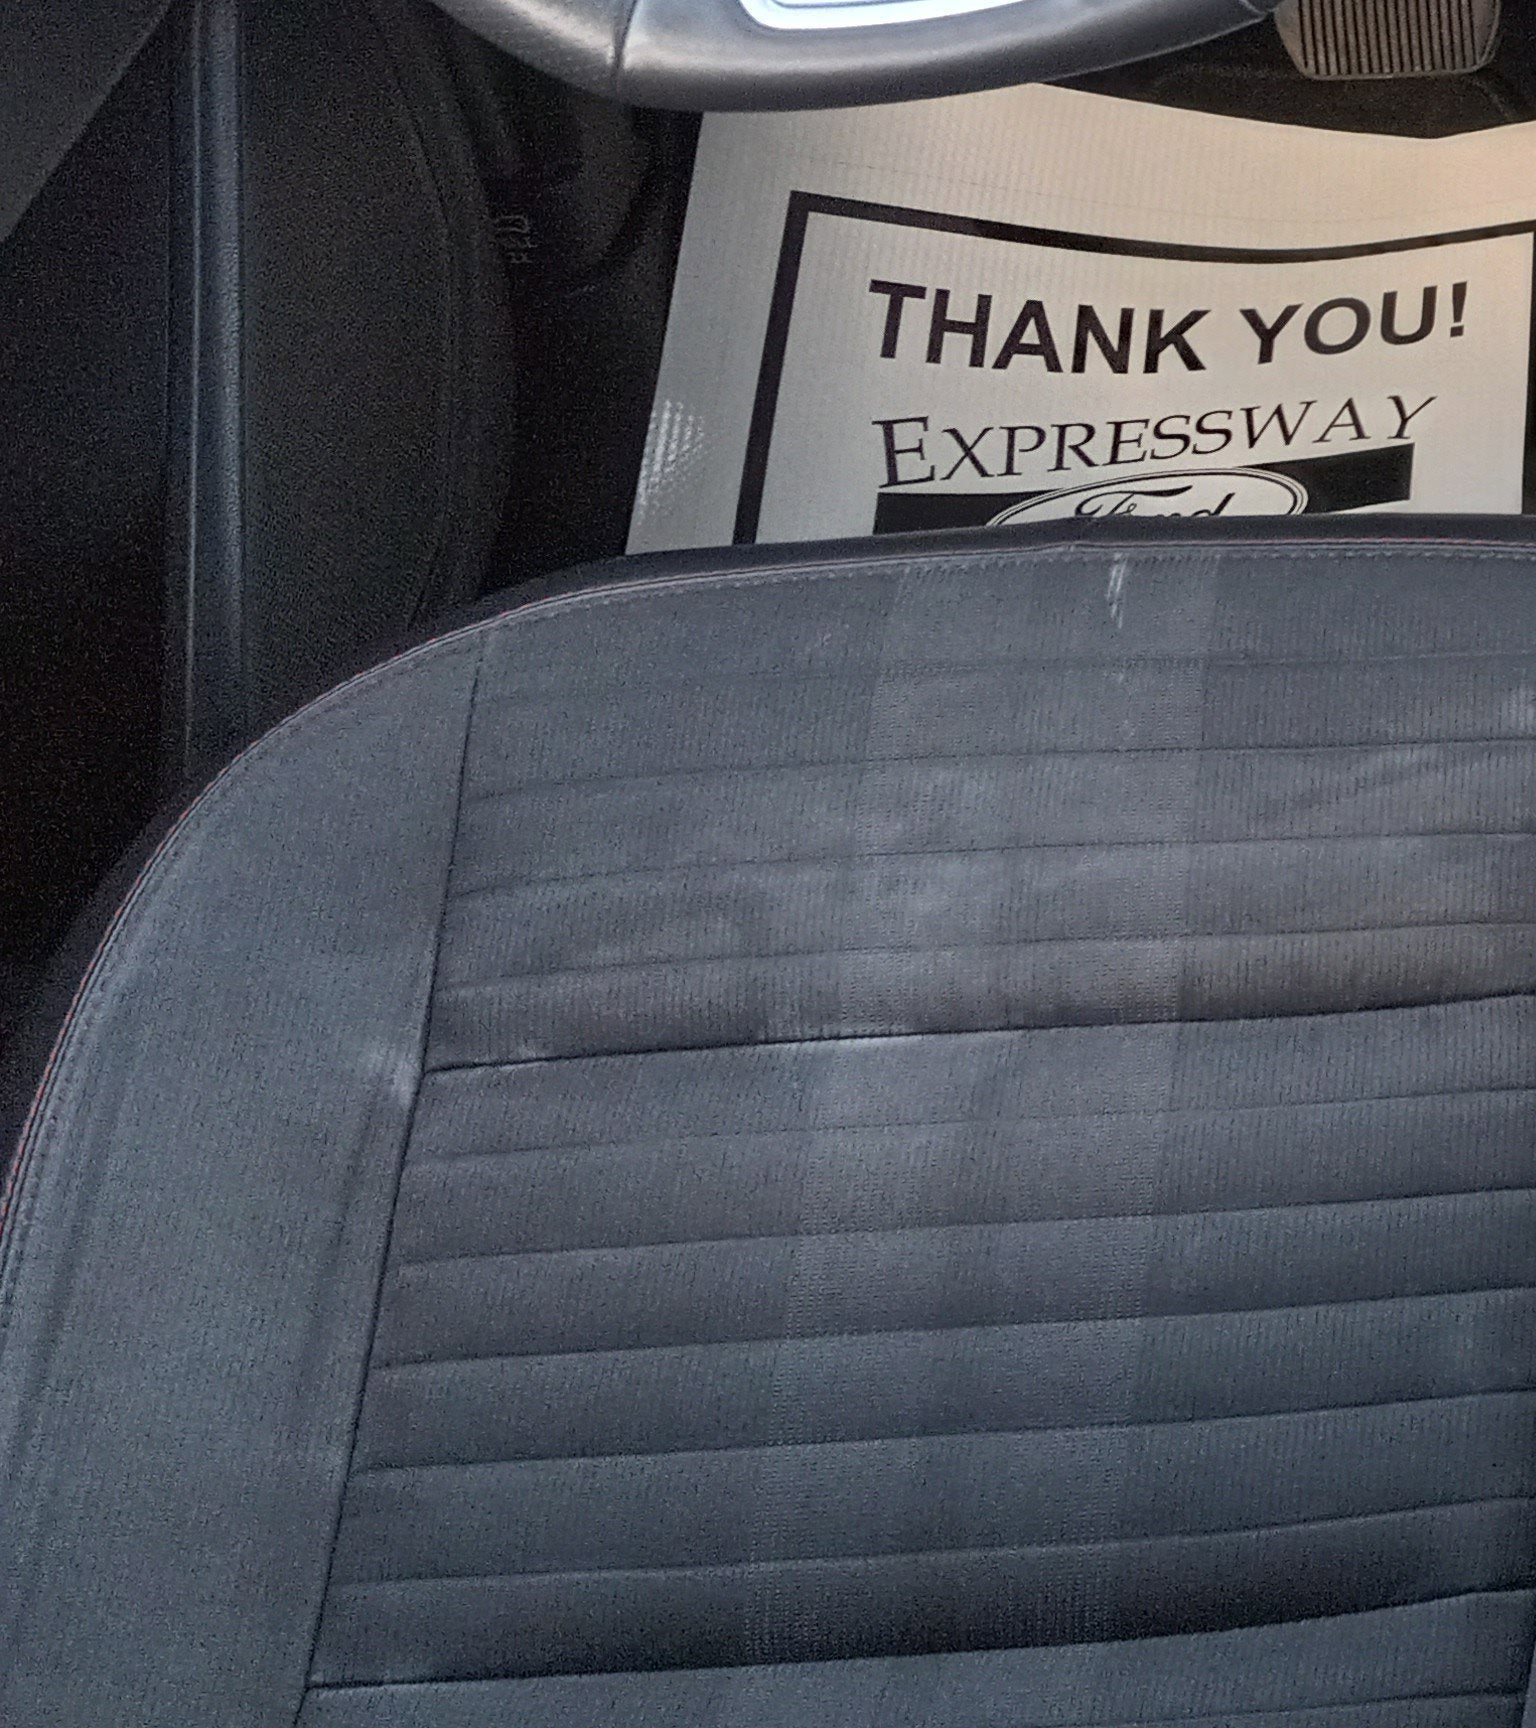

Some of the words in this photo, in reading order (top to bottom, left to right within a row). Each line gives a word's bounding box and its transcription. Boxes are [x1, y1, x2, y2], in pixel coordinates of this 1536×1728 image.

[869, 279, 1211, 374] THANK
[1239, 281, 1467, 364] YOU!
[871, 395, 1437, 488] EXPRESSWAY
